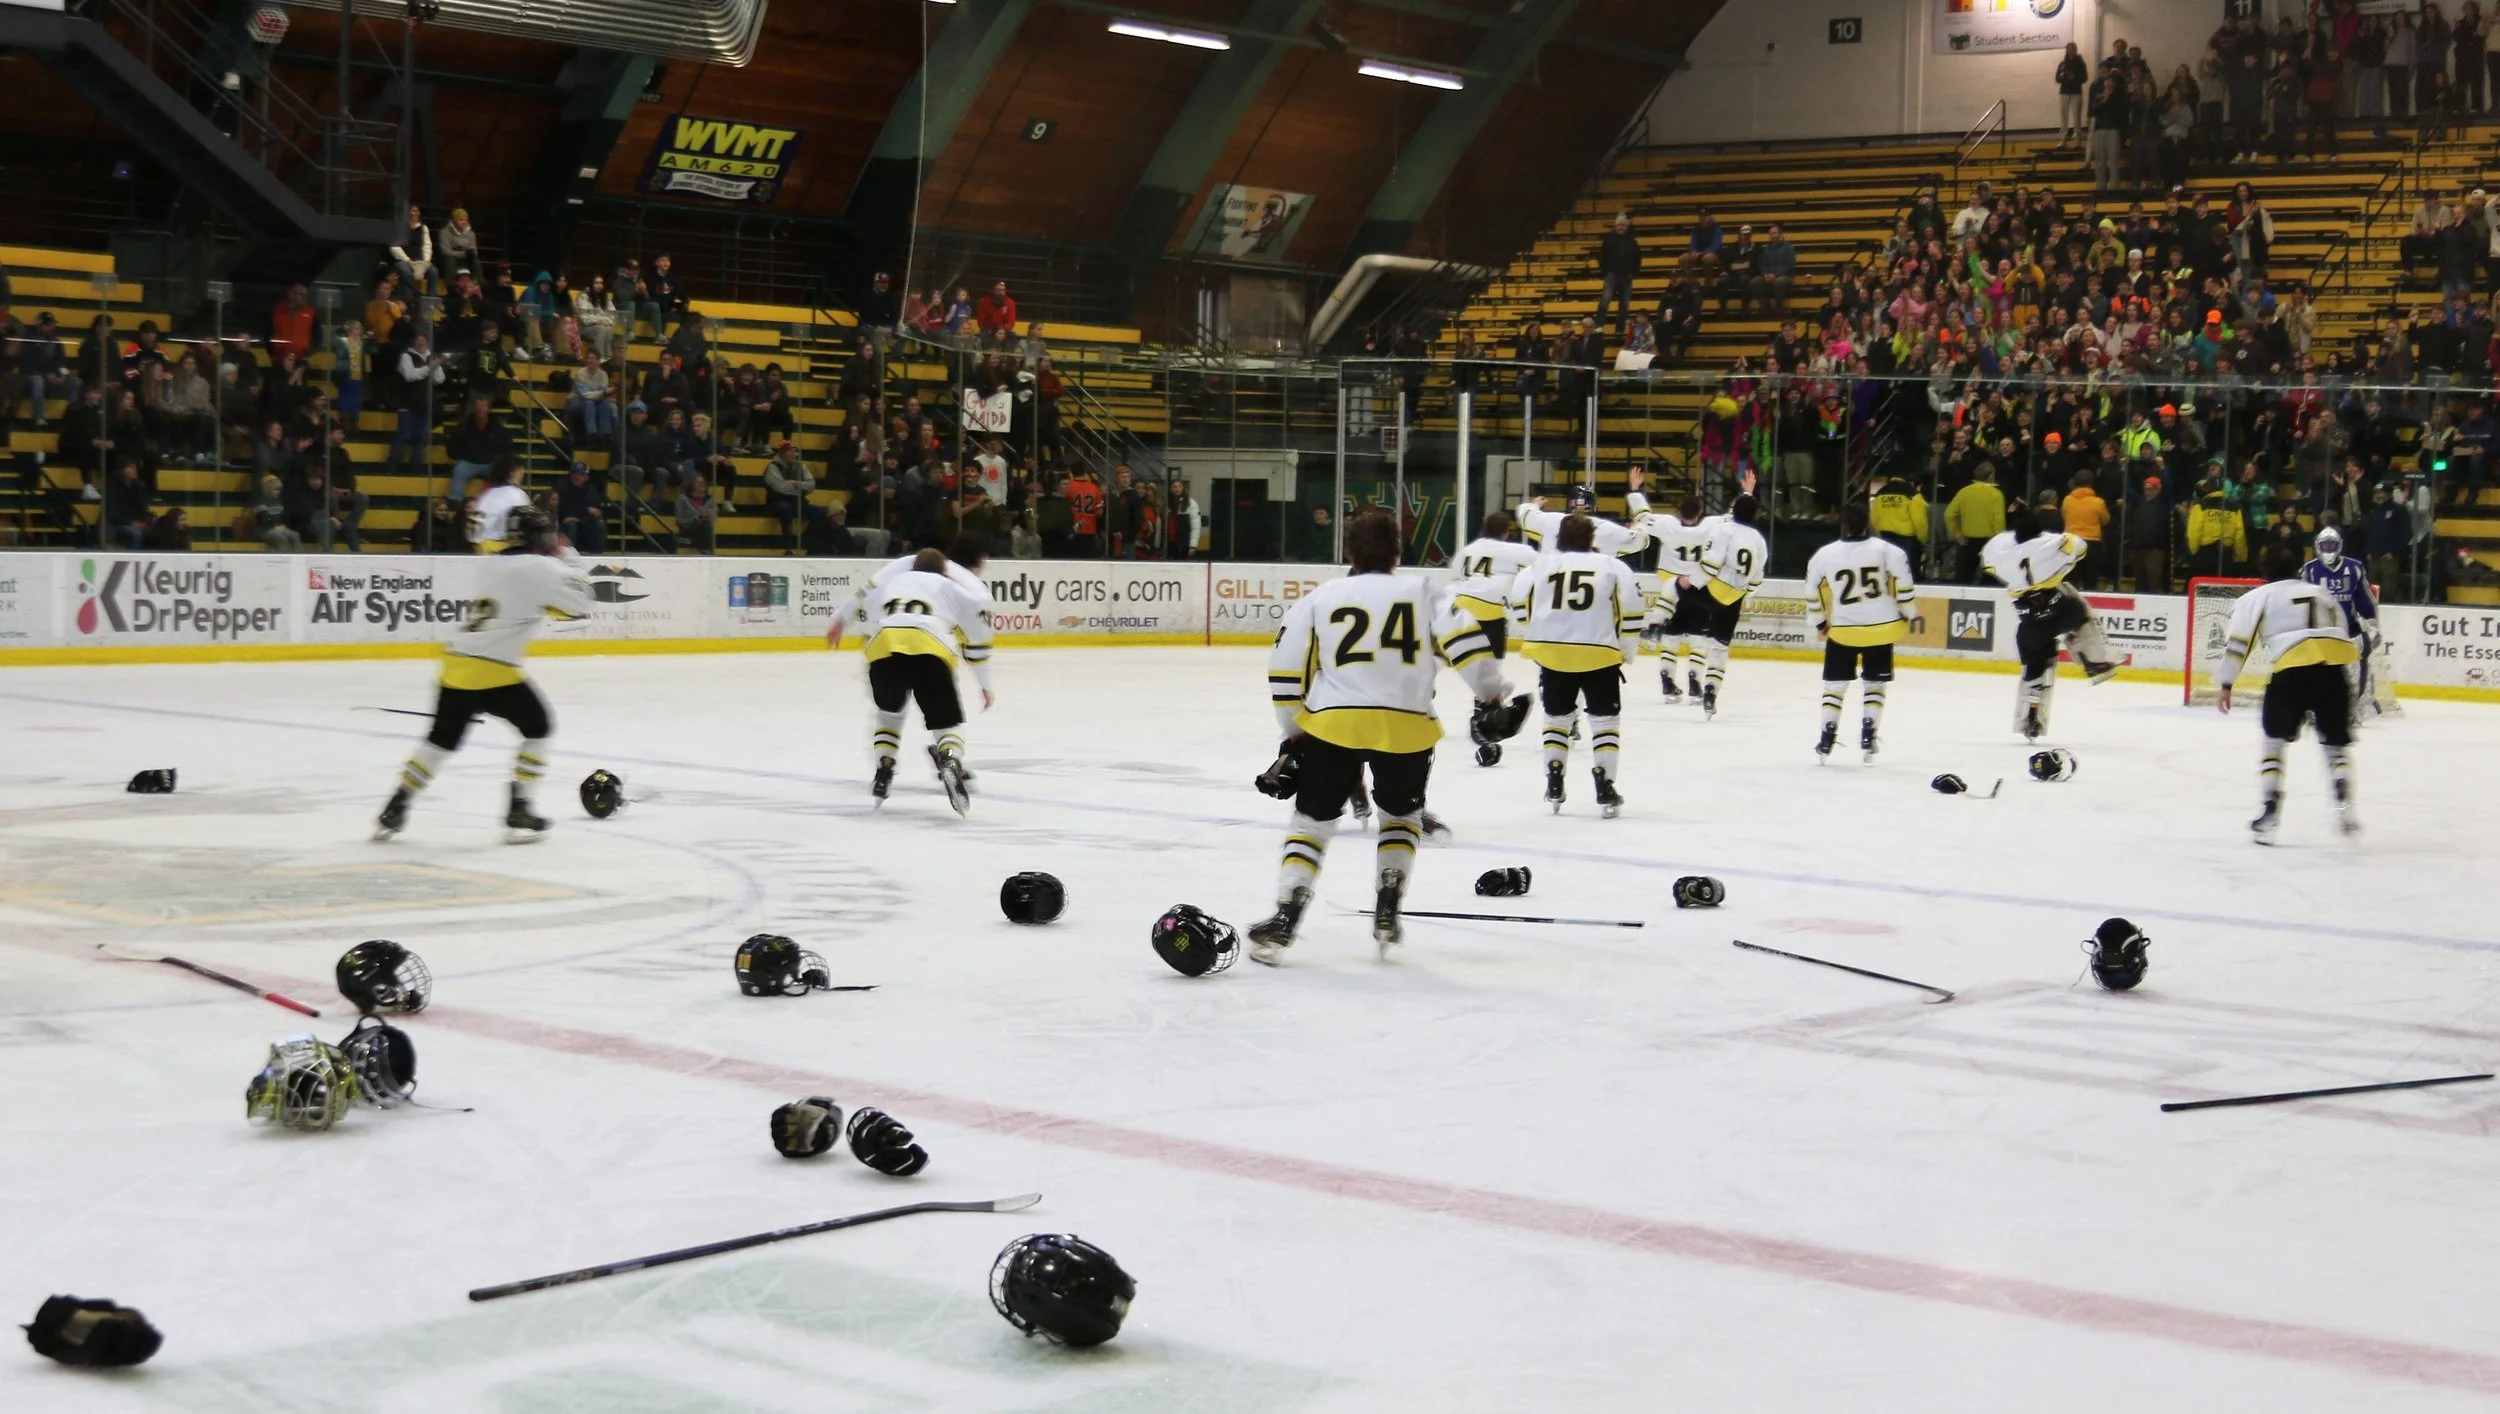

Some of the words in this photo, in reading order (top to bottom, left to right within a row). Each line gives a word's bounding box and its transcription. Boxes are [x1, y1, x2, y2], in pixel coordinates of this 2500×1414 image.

[1835, 21, 1856, 40] 10
[1975, 35, 2016, 47] Student
[2019, 33, 2059, 44] Section
[674, 117, 797, 160] WVMT
[1031, 122, 1047, 139] 9
[1073, 493, 1096, 515] 42
[1677, 545, 1702, 562] 11
[1737, 548, 1752, 577] 9
[1463, 555, 1494, 578] 14
[2020, 558, 2034, 586] 1
[135, 561, 232, 603] Keurig
[330, 575, 365, 590] New
[371, 575, 433, 593] England
[802, 574, 850, 587] Vermont
[988, 573, 1045, 609] ndy
[1216, 579, 1274, 600] GILL
[1547, 570, 1595, 611] 15
[1835, 567, 1883, 606] 25
[2328, 579, 2342, 590] 32
[802, 590, 830, 602] Paint
[312, 592, 358, 623] Air
[1215, 604, 1291, 620] AUTO
[1741, 600, 1807, 616] LUMBER
[134, 600, 281, 640] DrPepper
[991, 615, 1043, 630] OYOTA
[1089, 616, 1159, 628] CHEVROLET
[1951, 611, 1993, 639] CAT
[2422, 614, 2469, 637] Gut
[1330, 602, 1422, 668] 24
[2424, 643, 2458, 659] The
